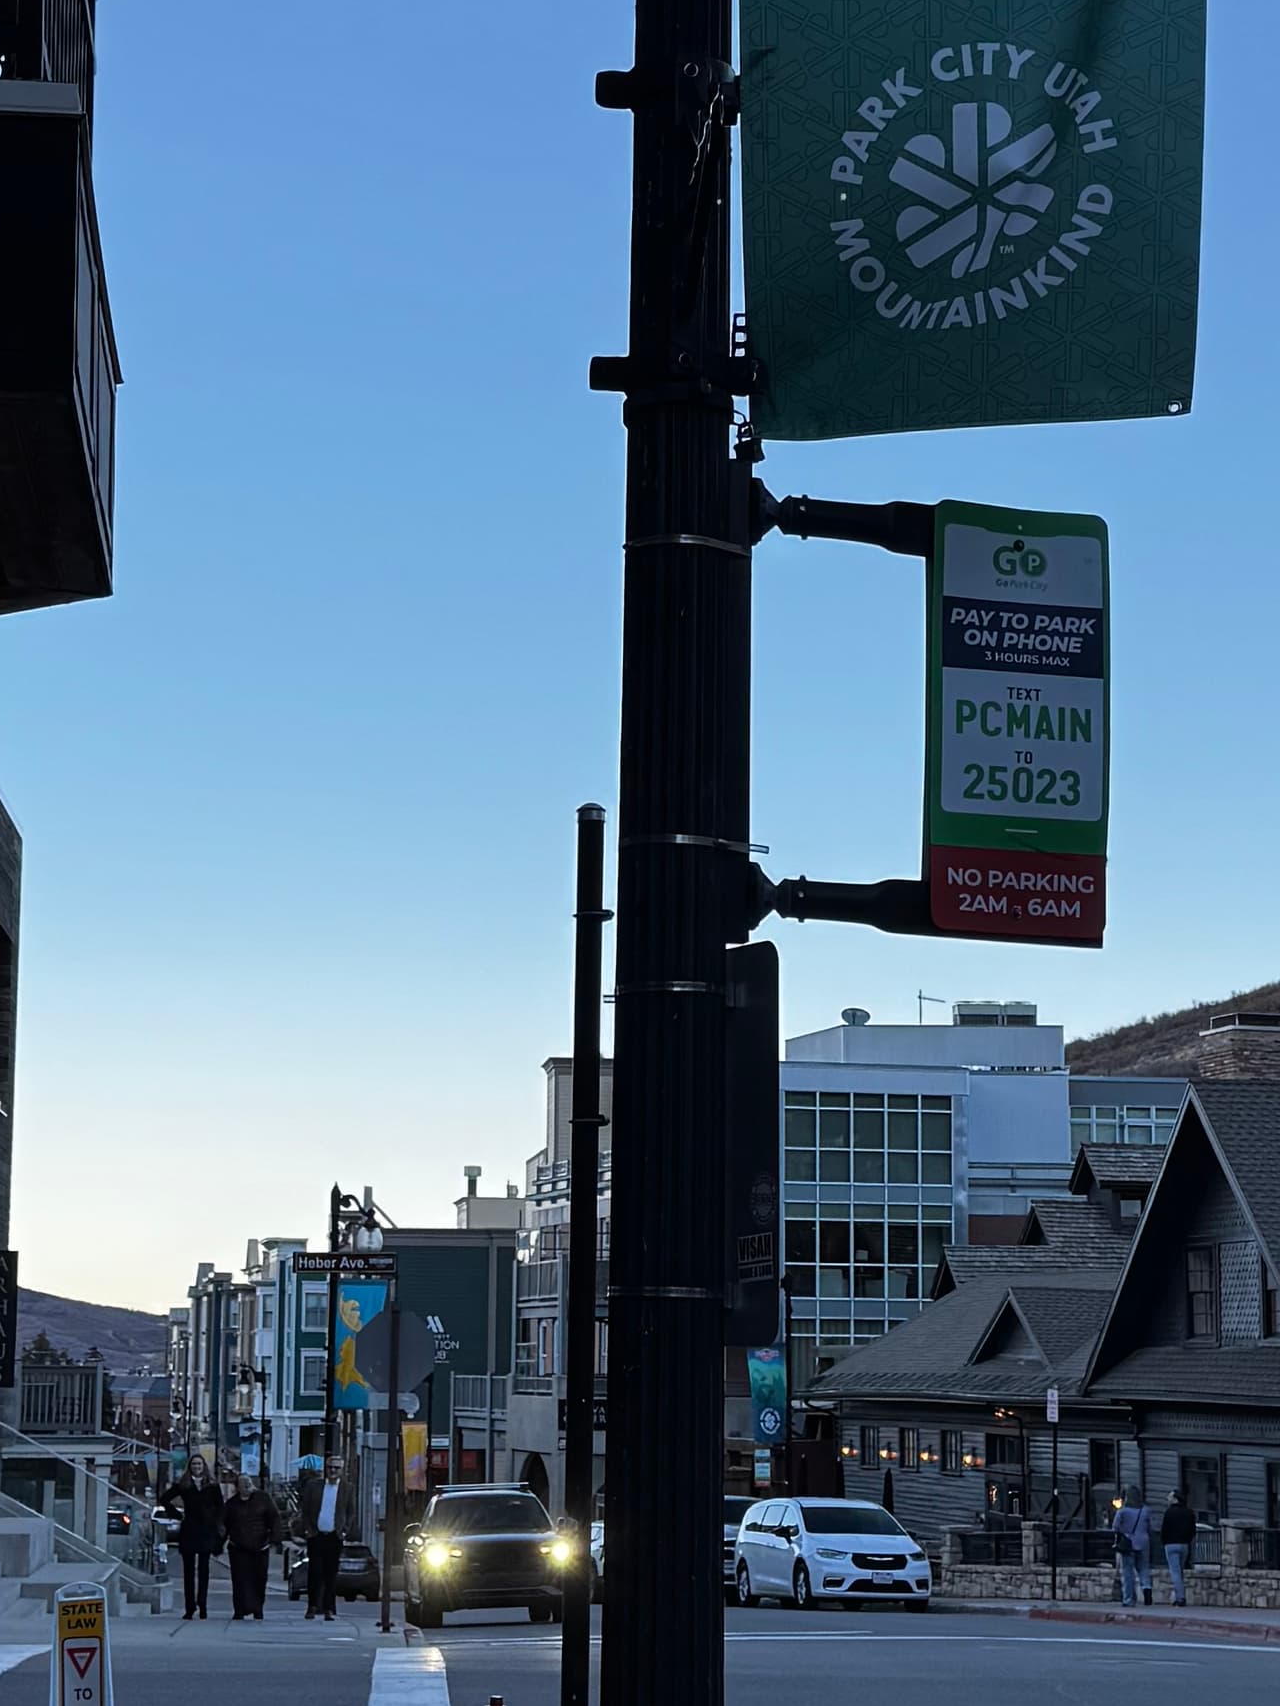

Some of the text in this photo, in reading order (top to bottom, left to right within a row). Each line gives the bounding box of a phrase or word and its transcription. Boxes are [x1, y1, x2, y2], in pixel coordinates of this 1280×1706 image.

[830, 42, 1119, 185] PARK CITY UTAH
[829, 183, 1114, 330] MOUNTAINKIND
[950, 607, 1097, 635] PAY TO PARK
[963, 629, 1084, 654] ON PHONE
[984, 650, 1071, 667] 3 HOURS MAX
[1007, 686, 1041, 702] TEXT
[955, 699, 1092, 743] PCMAIN
[1014, 750, 1033, 764] TO
[962, 763, 1081, 806] 25023
[946, 866, 1095, 894] NO PARKING
[958, 893, 1082, 918] 2AM 6AM
[298, 1255, 337, 1270] Heber
[339, 1255, 369, 1270] Ave.
[61, 1602, 103, 1616] STATE
[67, 1617, 97, 1629] LAW
[74, 1688, 93, 1701] TO
